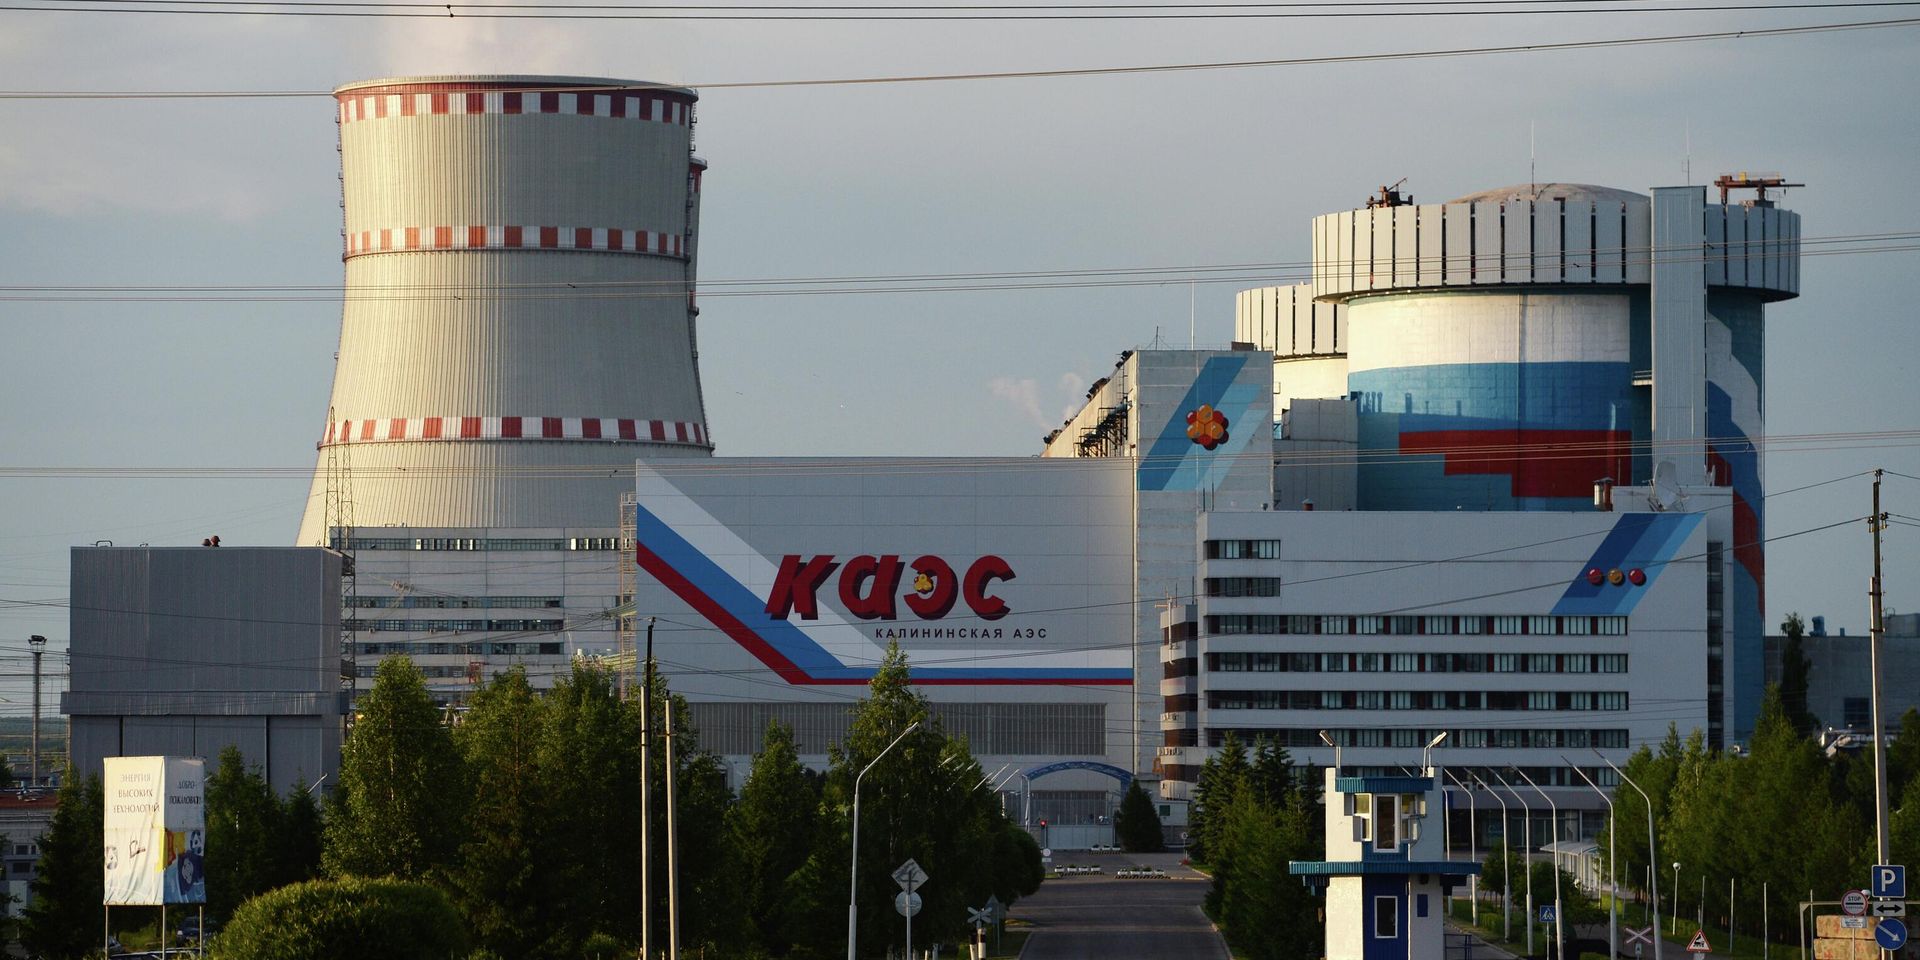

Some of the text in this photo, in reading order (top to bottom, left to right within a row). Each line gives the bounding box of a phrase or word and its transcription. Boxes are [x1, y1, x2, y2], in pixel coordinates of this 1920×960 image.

[875, 628, 1047, 639] КАЛИНИНСКАЯ АЭС
[118, 789, 153, 798] ВЫСОКИХ
[1881, 869, 1896, 892] P
